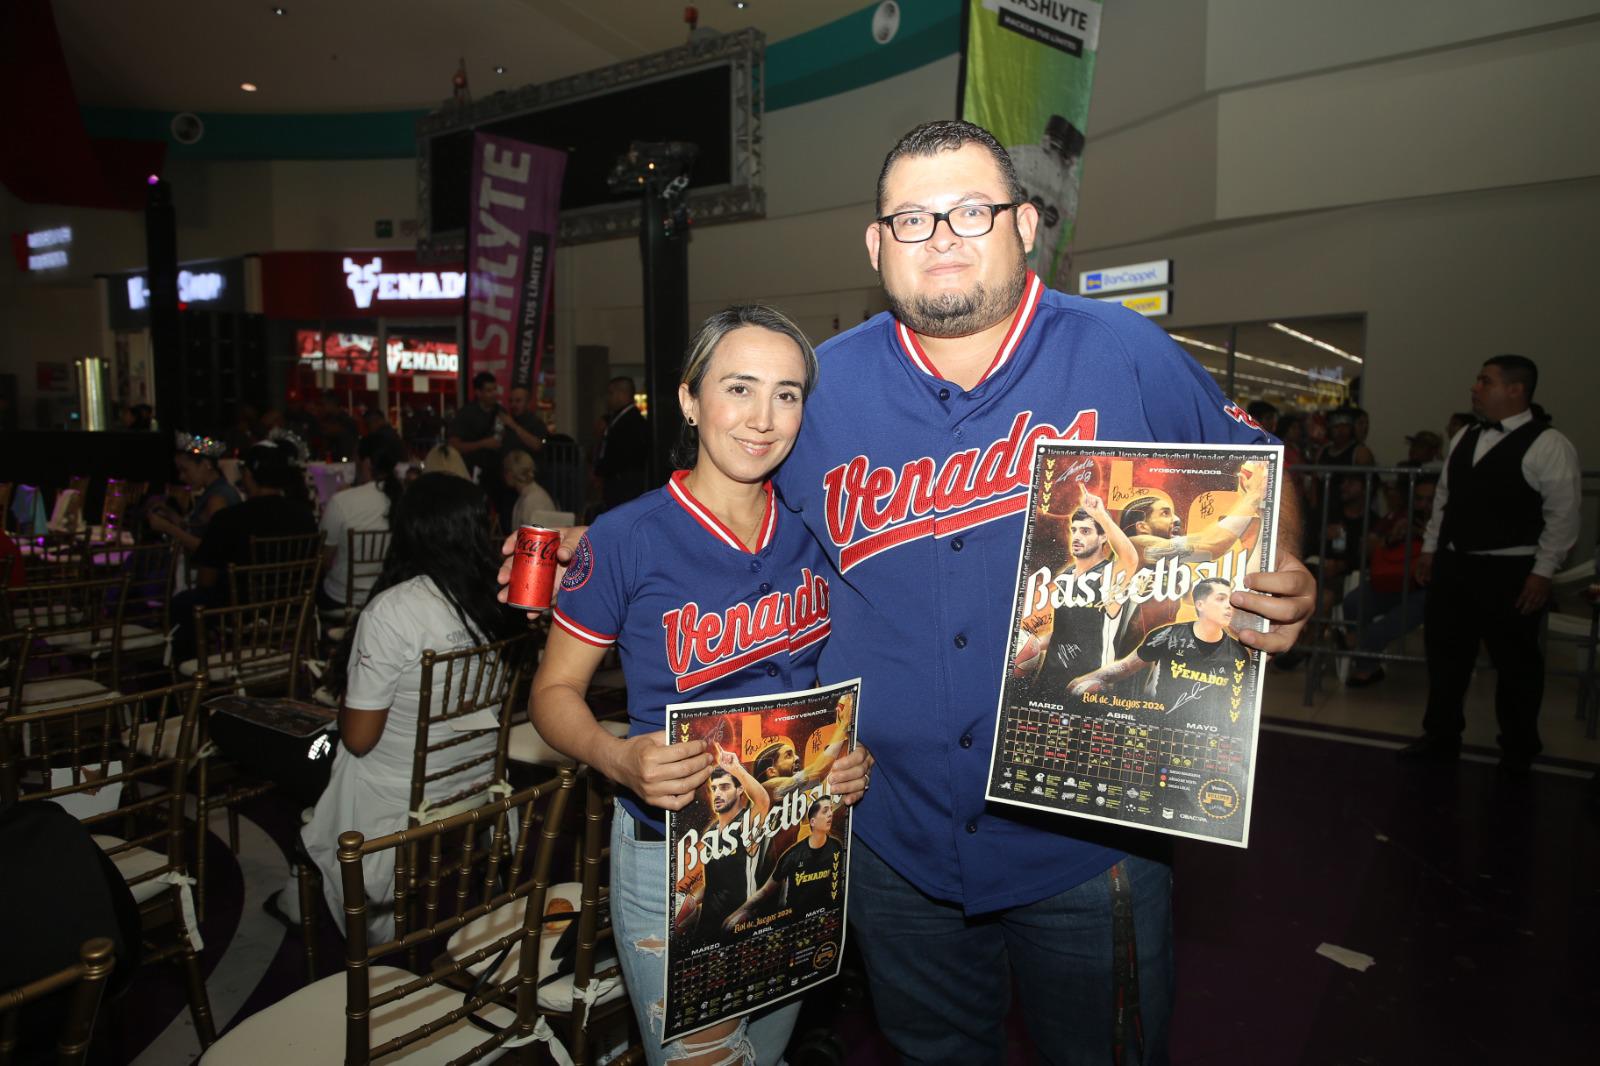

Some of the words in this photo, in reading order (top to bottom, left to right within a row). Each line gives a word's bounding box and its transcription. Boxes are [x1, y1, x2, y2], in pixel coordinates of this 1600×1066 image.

[1011, 0, 1088, 31] ASHLYTE
[525, 303, 537, 328] TUS
[519, 329, 533, 384] HACKEA
[1028, 700, 1064, 711] MARZO
[1142, 702, 1165, 711] 2024
[1106, 712, 1137, 721] ABRIL
[1186, 723, 1218, 733] MAYO
[805, 907, 826, 918] MAYO
[753, 926, 774, 936] ABRIL
[691, 942, 720, 956] MARZO
